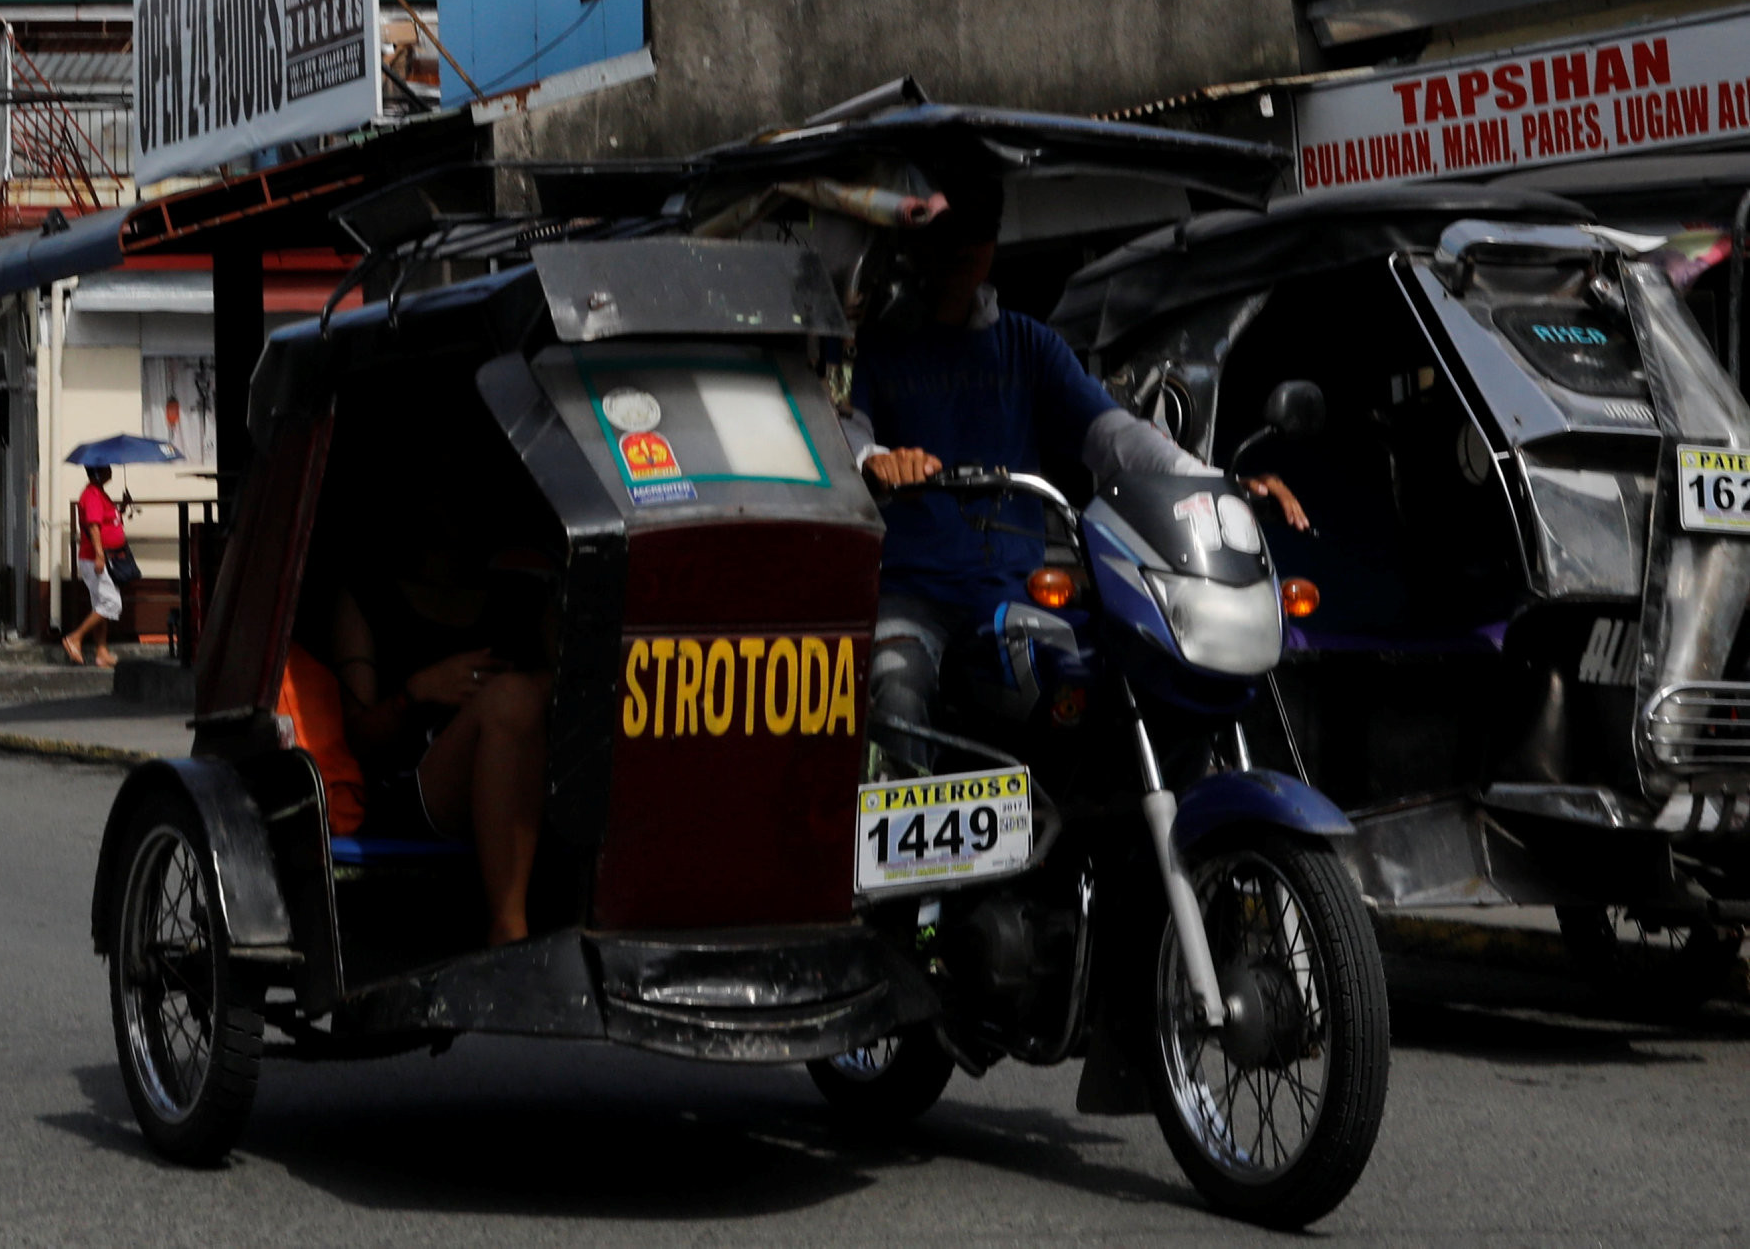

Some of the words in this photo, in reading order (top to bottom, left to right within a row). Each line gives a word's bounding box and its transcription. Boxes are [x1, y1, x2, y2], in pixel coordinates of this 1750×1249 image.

[1392, 37, 1671, 126] TAPSIHAN
[1303, 129, 1438, 189] BULALUHAN,
[1441, 117, 1518, 170] MAMI,
[1522, 102, 1608, 159] PARES,
[1613, 84, 1710, 145] LUGAW
[1717, 76, 1750, 131] At
[623, 636, 856, 739] STROTODA
[867, 805, 999, 864] 1449
[885, 778, 1001, 810] PATEROS
